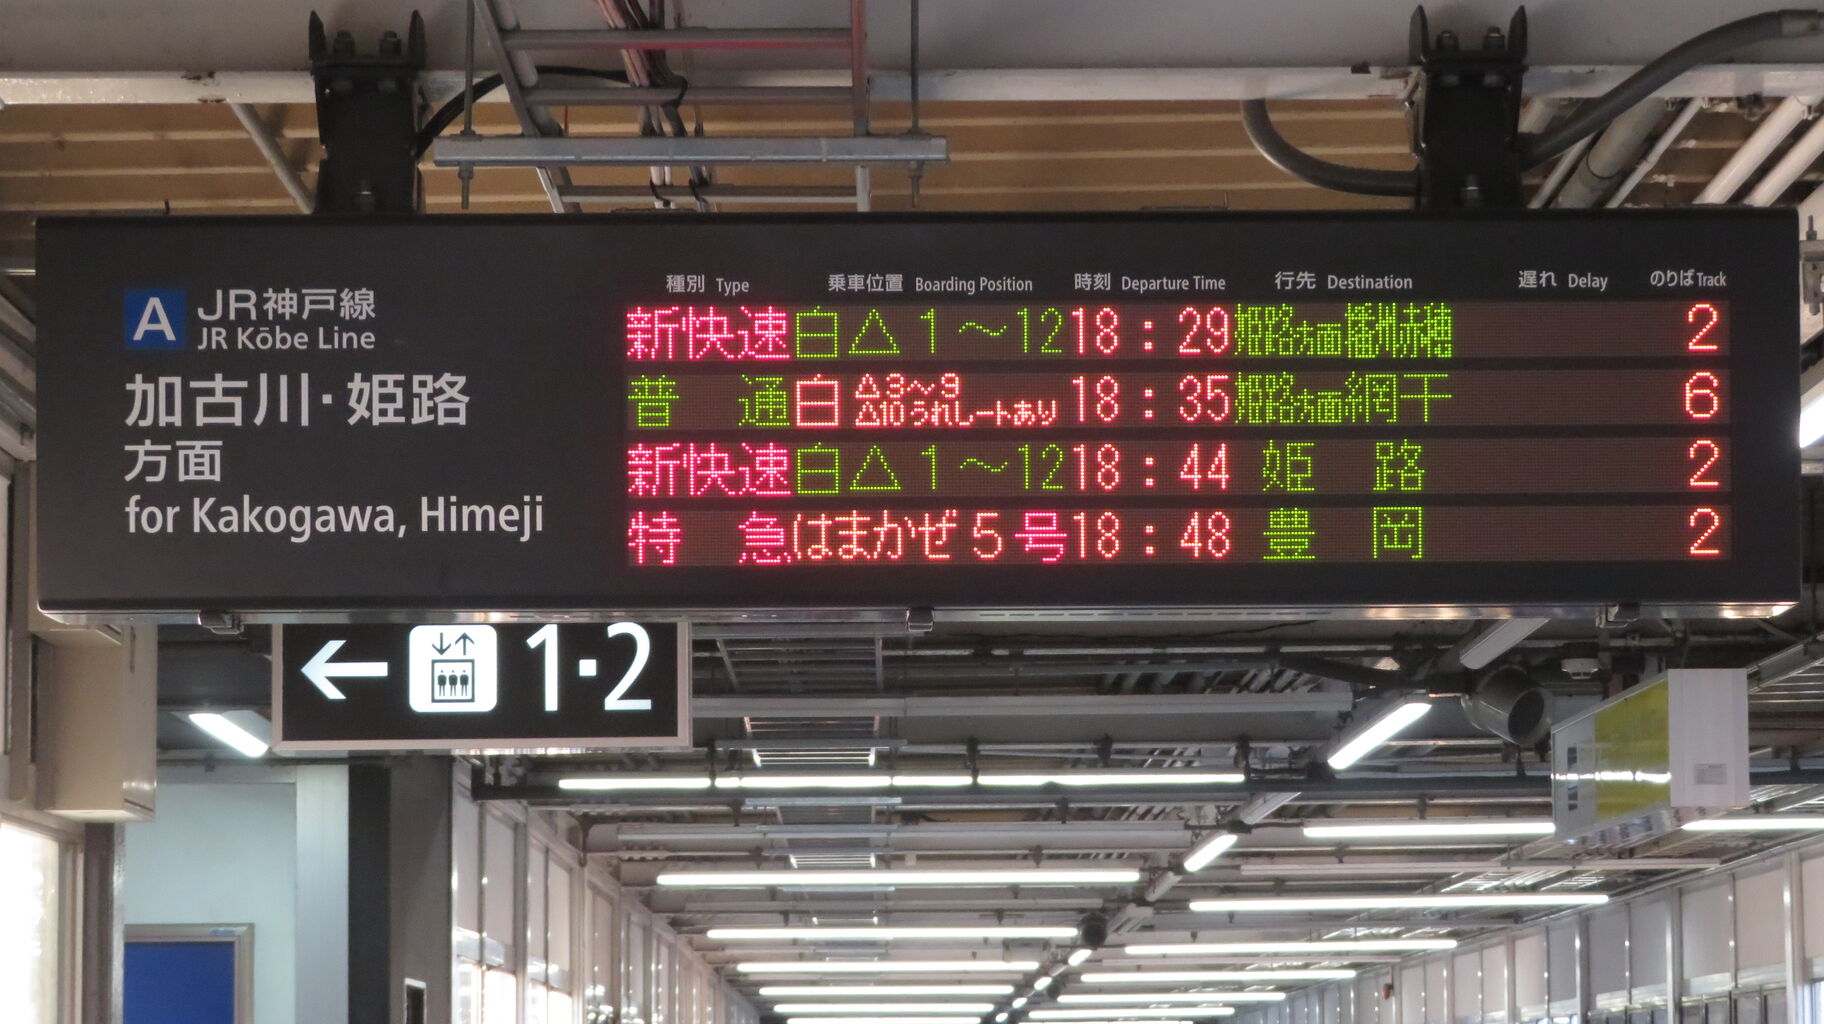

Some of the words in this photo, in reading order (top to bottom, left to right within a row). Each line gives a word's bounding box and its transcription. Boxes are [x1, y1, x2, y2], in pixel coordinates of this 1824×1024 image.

[666, 274, 705, 294] 種別
[716, 278, 750, 296] Type
[828, 273, 903, 293] 乗車位置
[915, 276, 976, 296] Boarding
[979, 276, 1033, 293] Position
[1074, 272, 1111, 291] 時刻
[1121, 275, 1190, 293] Departure
[1192, 275, 1226, 291] Time
[1274, 271, 1316, 291] 行先
[1327, 274, 1413, 290] Destination
[1518, 269, 1557, 289] 遅れ
[1568, 273, 1608, 291] Delay
[1650, 268, 1694, 287] のりば
[1696, 271, 1727, 287] Track
[133, 297, 175, 341] A
[197, 287, 376, 321] JR神戸線
[197, 326, 228, 350] JR
[237, 325, 309, 349] Kōbe
[318, 326, 376, 349] Line
[627, 306, 790, 360] 新快速
[1688, 303, 1720, 353] 2
[1685, 371, 1720, 420] 6
[124, 439, 223, 483] 方面
[628, 442, 791, 496] 新快速
[1688, 439, 1721, 489] 2
[125, 494, 181, 533] for
[193, 494, 407, 543] Kakogawa,
[421, 496, 544, 543] Himeji
[1689, 507, 1721, 557] 2
